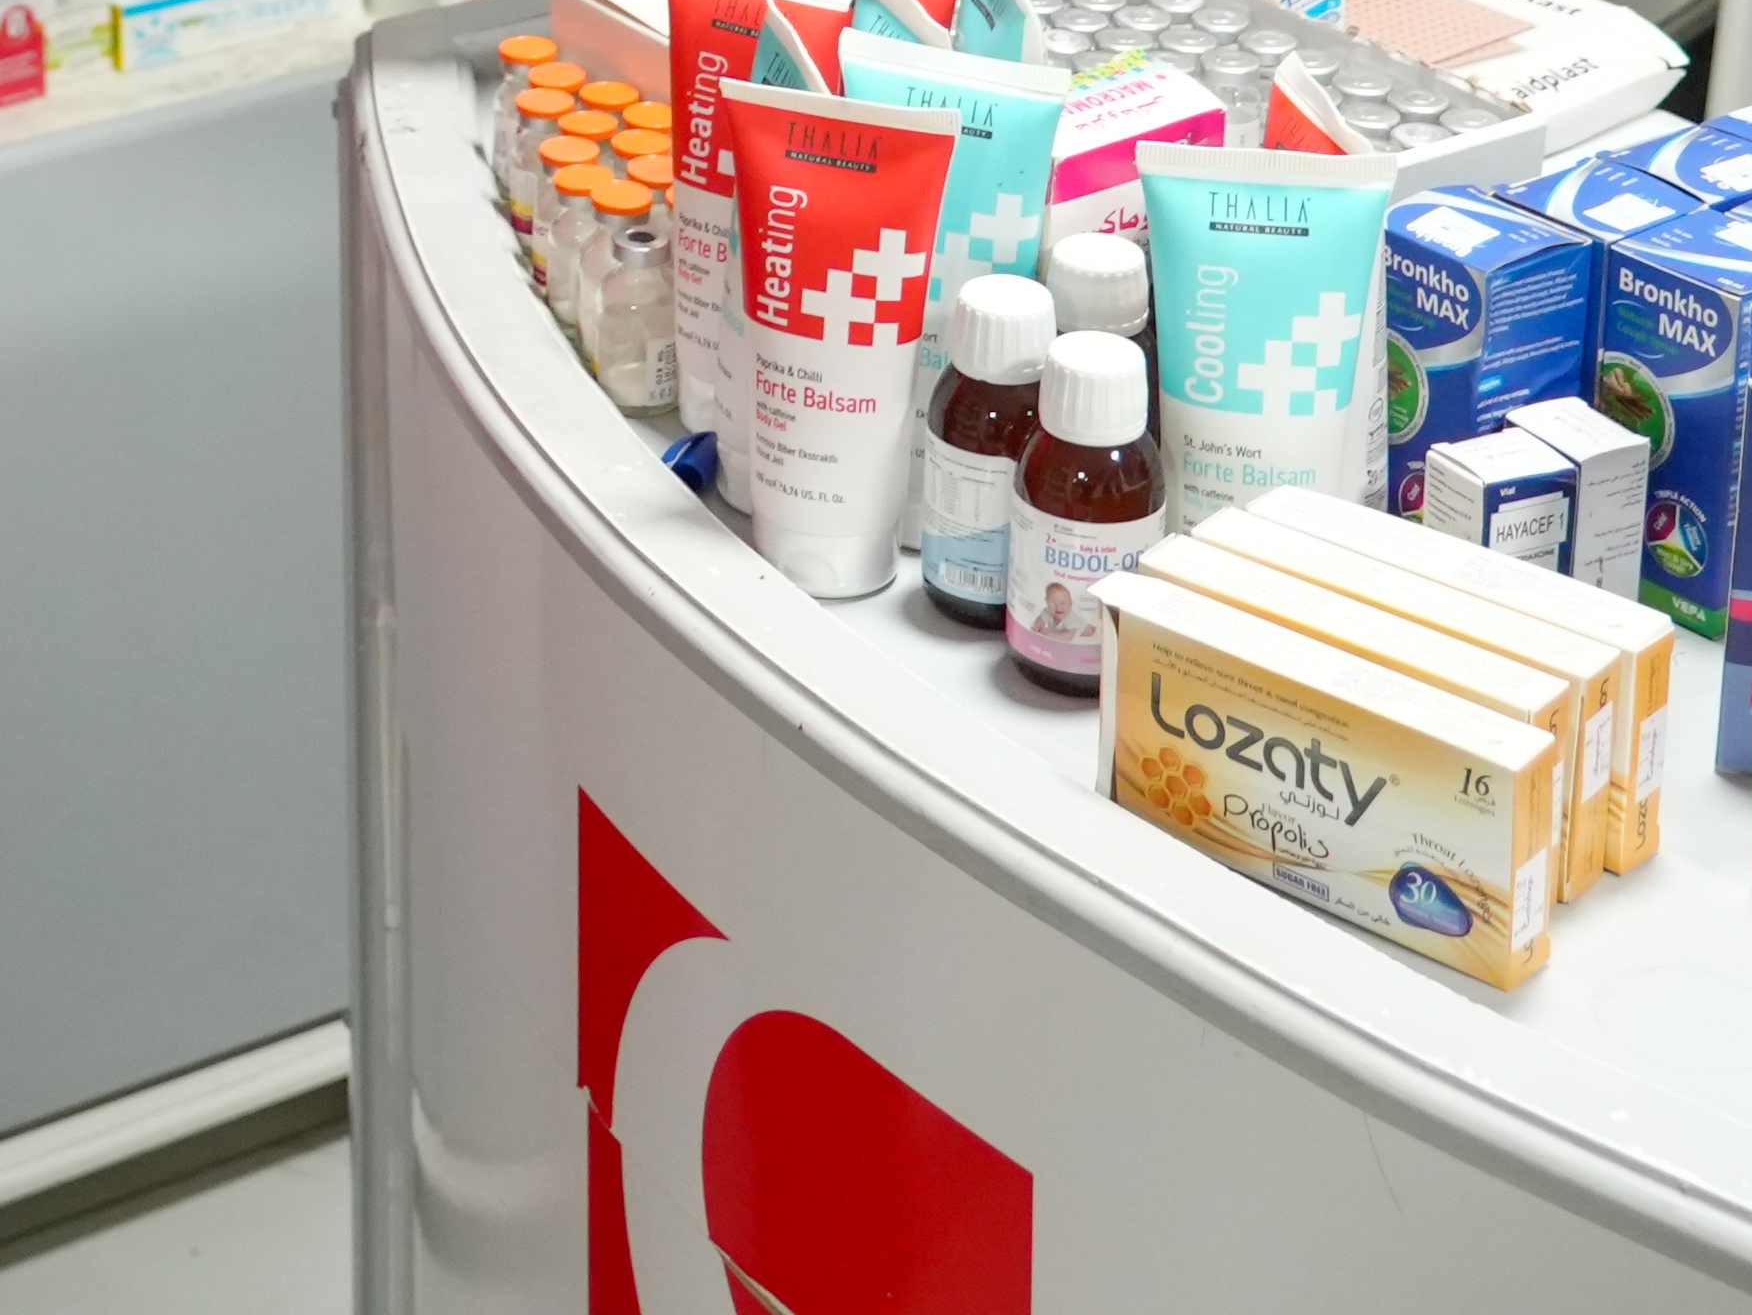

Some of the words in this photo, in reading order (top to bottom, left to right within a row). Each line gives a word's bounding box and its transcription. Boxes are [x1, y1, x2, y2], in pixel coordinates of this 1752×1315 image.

[1511, 55, 1599, 101] aidplast
[680, 49, 729, 185] Heating
[1062, 79, 1156, 118] MACROMA
[787, 120, 882, 160] THALIA
[790, 151, 834, 166] NATURAL
[835, 158, 873, 173] BEAUTY
[1207, 189, 1313, 225] THALIA
[678, 228, 712, 258] Forte
[1214, 221, 1259, 235] NATURAL
[1263, 225, 1305, 237] BEAUTY
[756, 184, 809, 327] Heating
[1415, 286, 1470, 331] MAX
[1618, 267, 1719, 329] Bronkho
[1184, 262, 1240, 404] Cooling
[1657, 312, 1718, 358] MAX
[756, 370, 797, 405] Forte
[803, 386, 877, 414] Balsam
[1202, 436, 1233, 458] John's
[1234, 444, 1263, 460] Wort
[1183, 454, 1235, 485] Forte
[1240, 462, 1317, 489] Balsam
[1499, 485, 1516, 498] Vial
[1495, 513, 1555, 543] HAYACEF
[1557, 511, 1565, 529] 1
[1150, 670, 1387, 828] Lozaty
[1457, 766, 1493, 798] 16
[1410, 831, 1459, 863] Throat
[1399, 870, 1438, 906] 30
